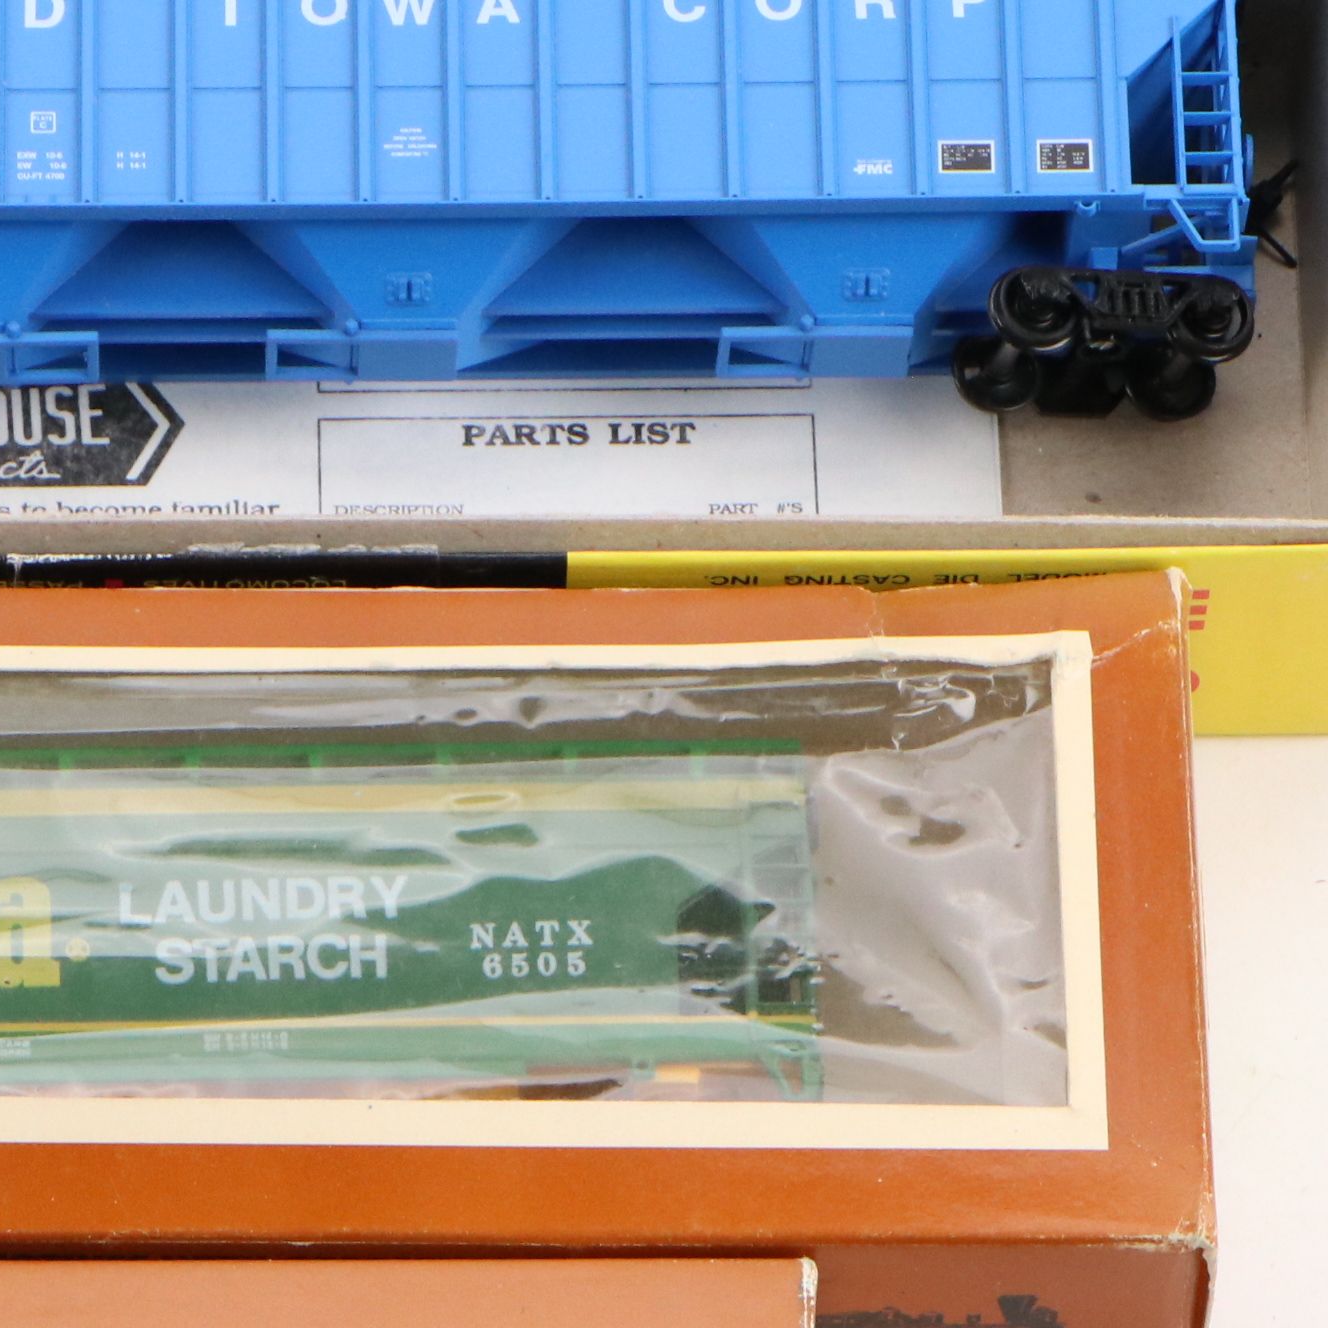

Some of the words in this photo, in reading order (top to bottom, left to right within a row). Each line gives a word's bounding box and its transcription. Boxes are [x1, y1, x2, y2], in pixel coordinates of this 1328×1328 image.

[461, 422, 591, 447] PARTS
[608, 421, 698, 445] LIST
[708, 502, 759, 515] PART
[703, 575, 759, 585] INC.
[782, 574, 911, 586] CASTING
[118, 874, 409, 929] LAUNDRY
[469, 919, 594, 951] NATX
[154, 932, 389, 985] STARCH
[481, 951, 588, 980] 6505
